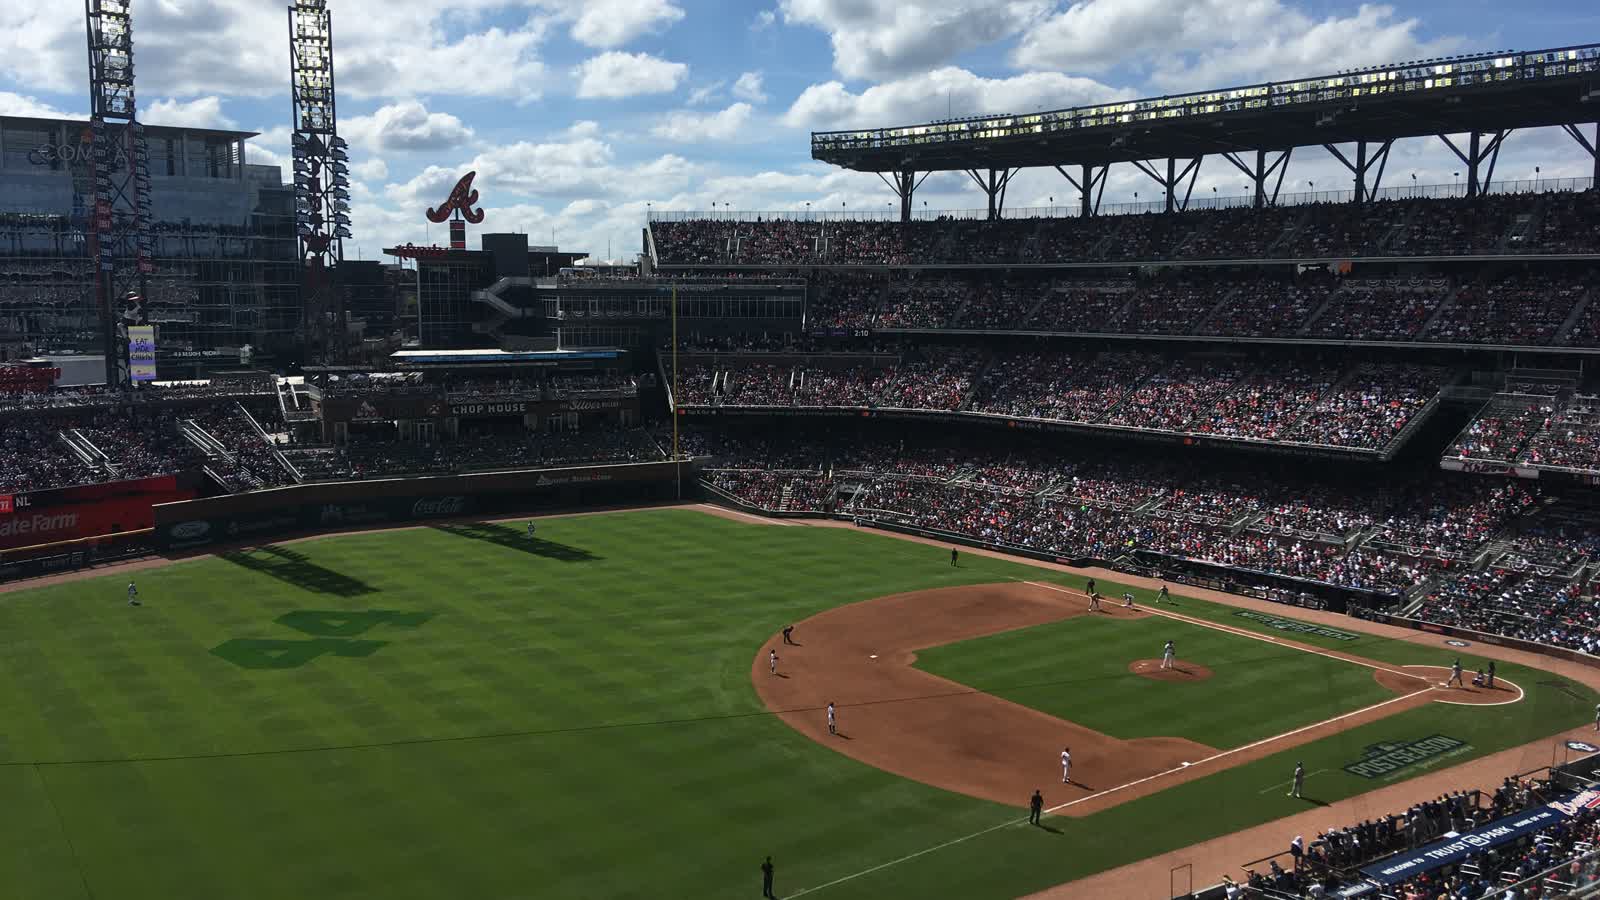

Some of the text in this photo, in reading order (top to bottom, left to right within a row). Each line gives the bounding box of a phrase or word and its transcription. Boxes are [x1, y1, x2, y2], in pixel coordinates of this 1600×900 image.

[452, 403, 526, 414] CHOP HOUSE
[16, 496, 31, 507] NL
[1346, 735, 1460, 778] POSTSEASON
[1382, 860, 1416, 875] WELCOME
[1412, 856, 1425, 866] TO
[1424, 841, 1470, 860] TRUIST
[1479, 826, 1516, 841] PARK
